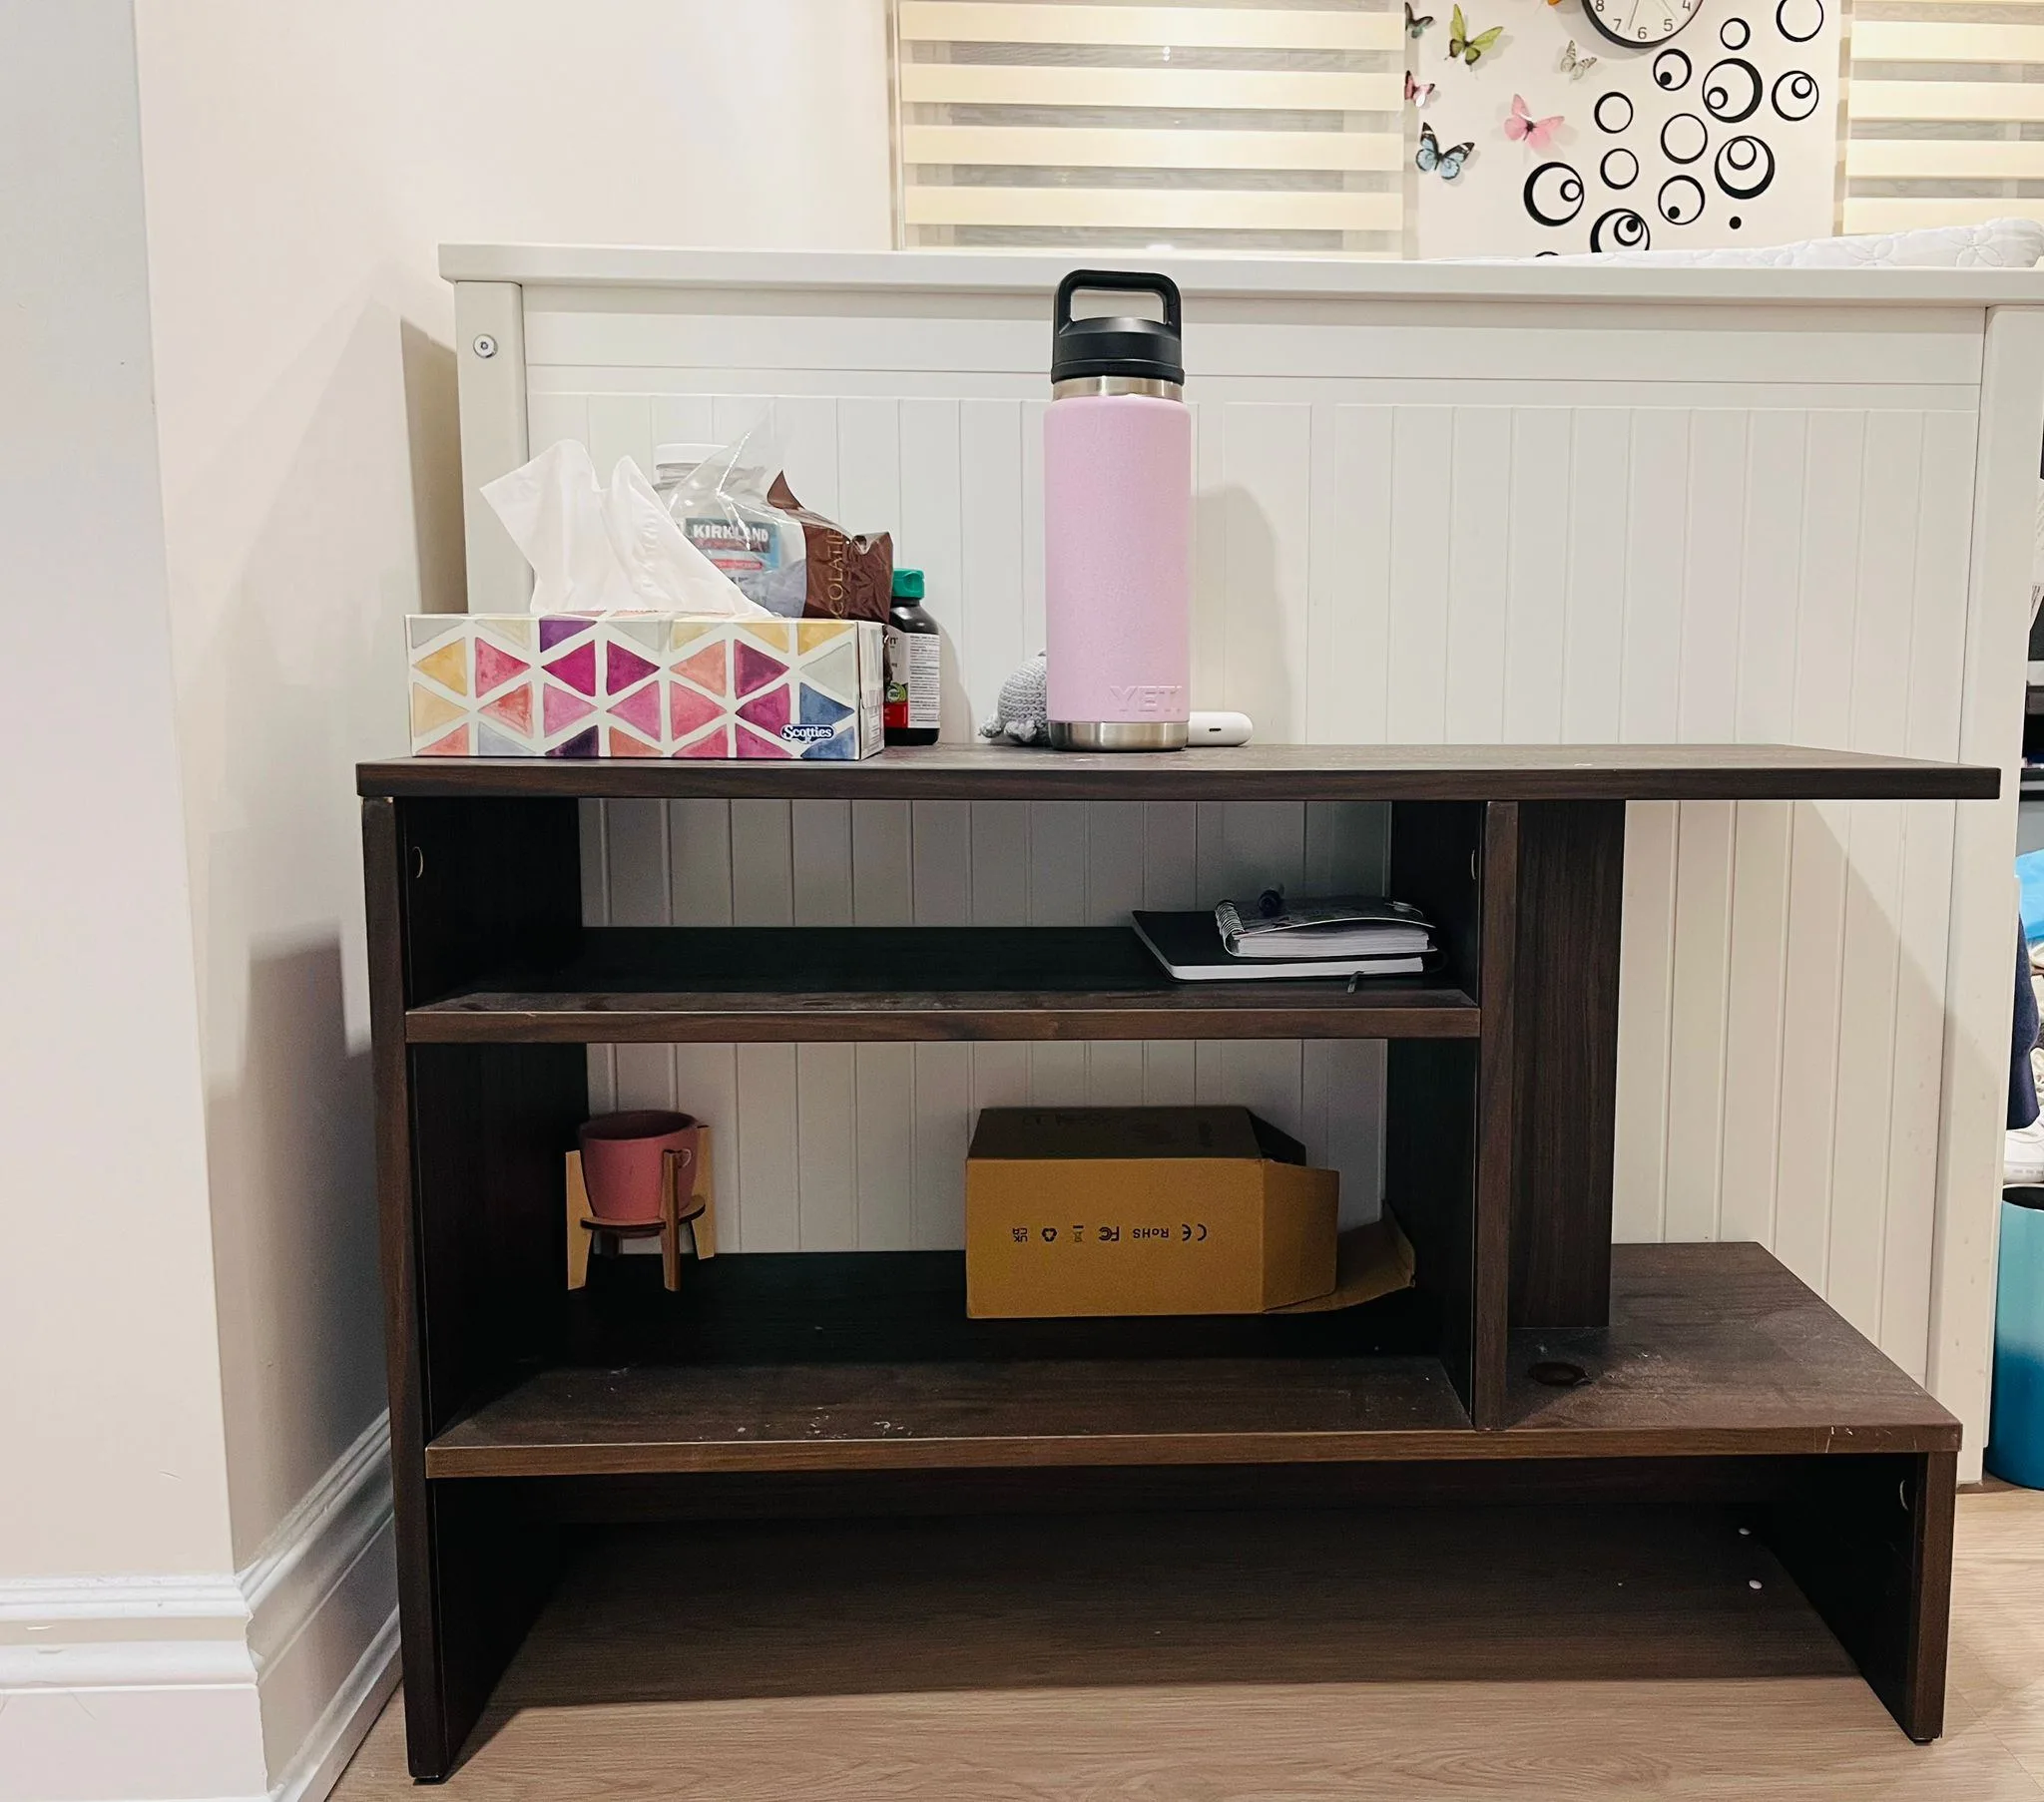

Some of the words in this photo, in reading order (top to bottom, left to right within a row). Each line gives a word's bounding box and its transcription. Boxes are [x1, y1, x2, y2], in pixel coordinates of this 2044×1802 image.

[1596, 0, 1605, 12] 8
[1682, 0, 1691, 11] 4
[1613, 18, 1622, 32] 7
[1663, 18, 1674, 32] 5
[1637, 26, 1647, 40] 6
[1109, 685, 1183, 712] YETI
[781, 723, 832, 742] Scotties
[1132, 1227, 1170, 1239] RoHS
